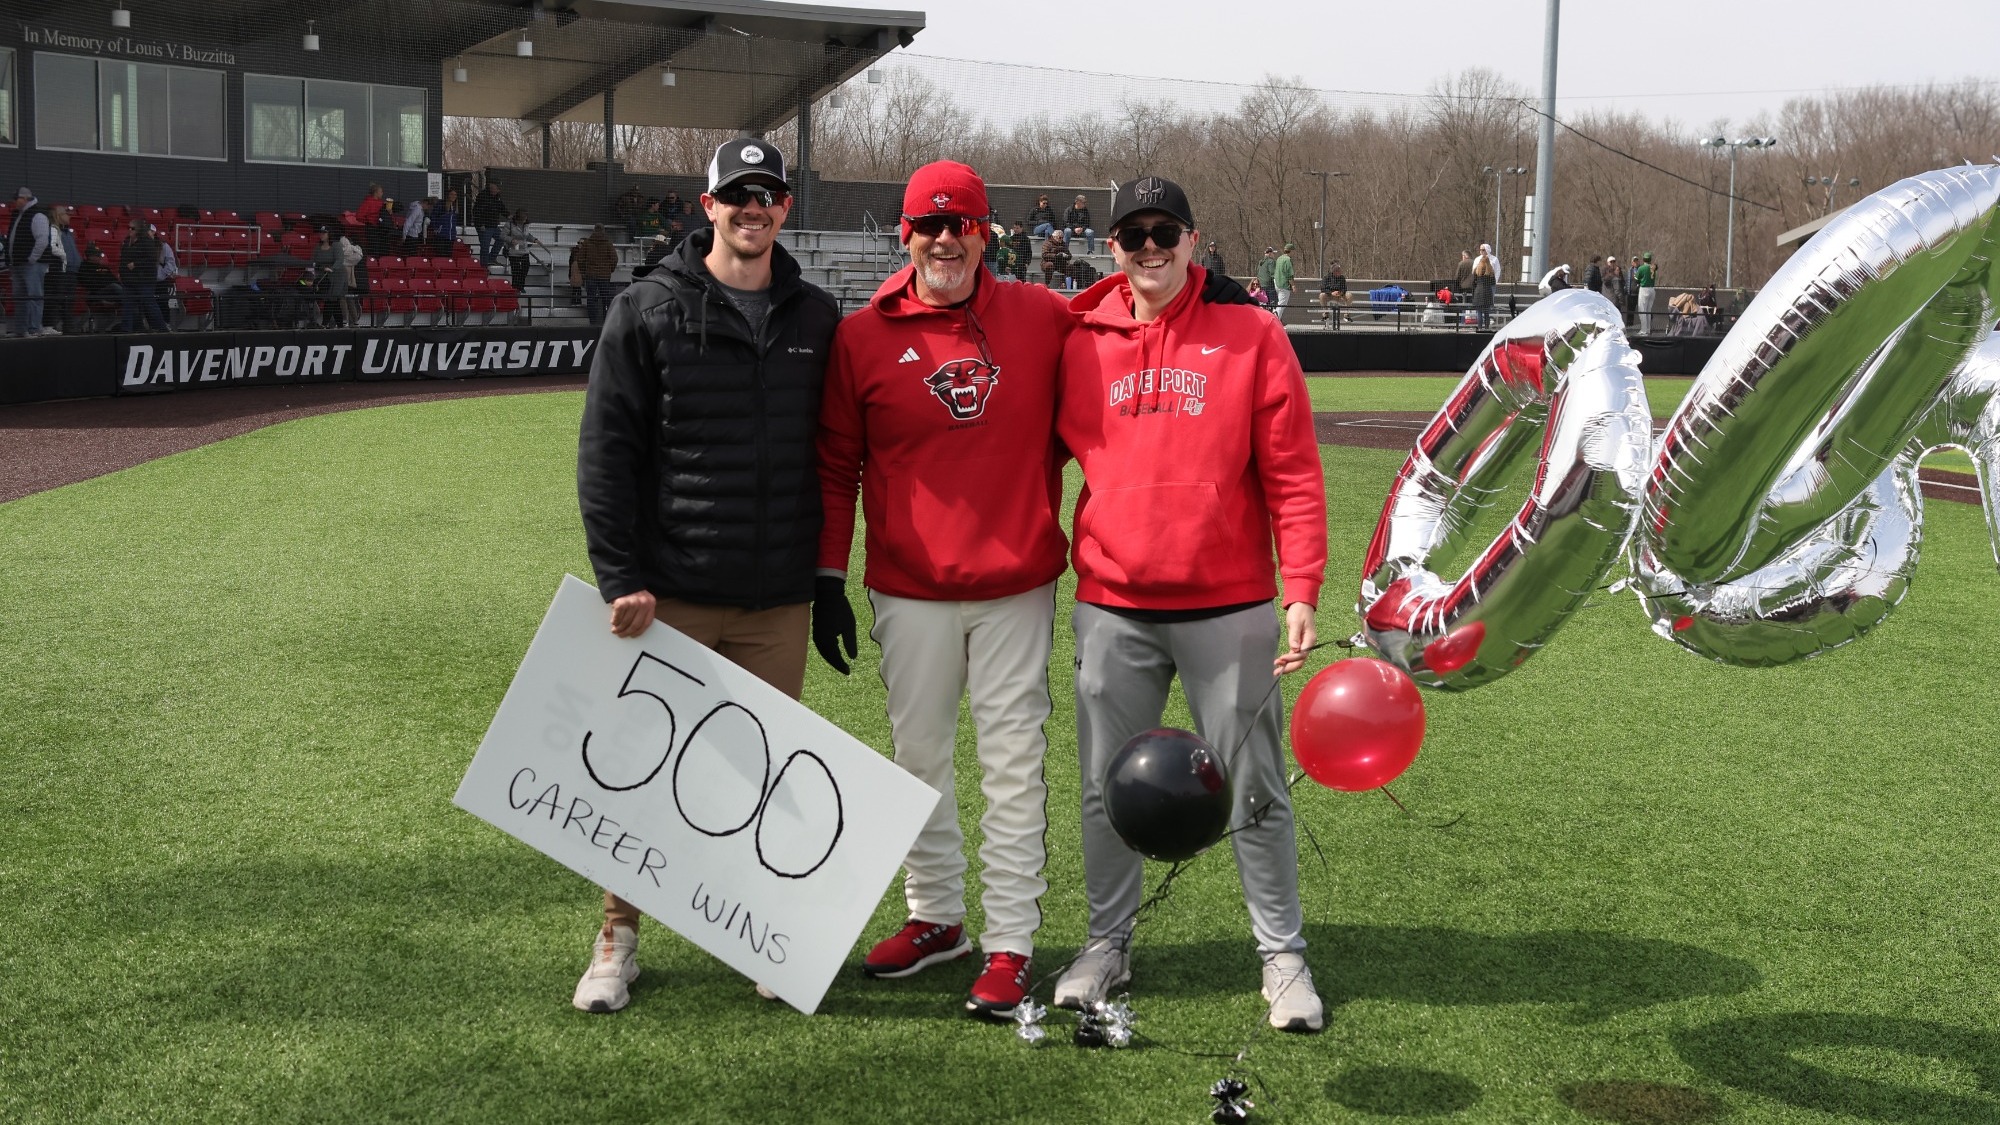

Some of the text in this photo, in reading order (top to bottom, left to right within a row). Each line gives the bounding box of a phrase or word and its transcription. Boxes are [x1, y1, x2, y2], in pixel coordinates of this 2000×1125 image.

[24, 28, 235, 65] In Memory of Louis V. Buzzitta
[123, 339, 594, 385] DAVENPORT UNIVERSITY
[581, 650, 844, 879] 500
[508, 767, 791, 965] CAREER WINS
